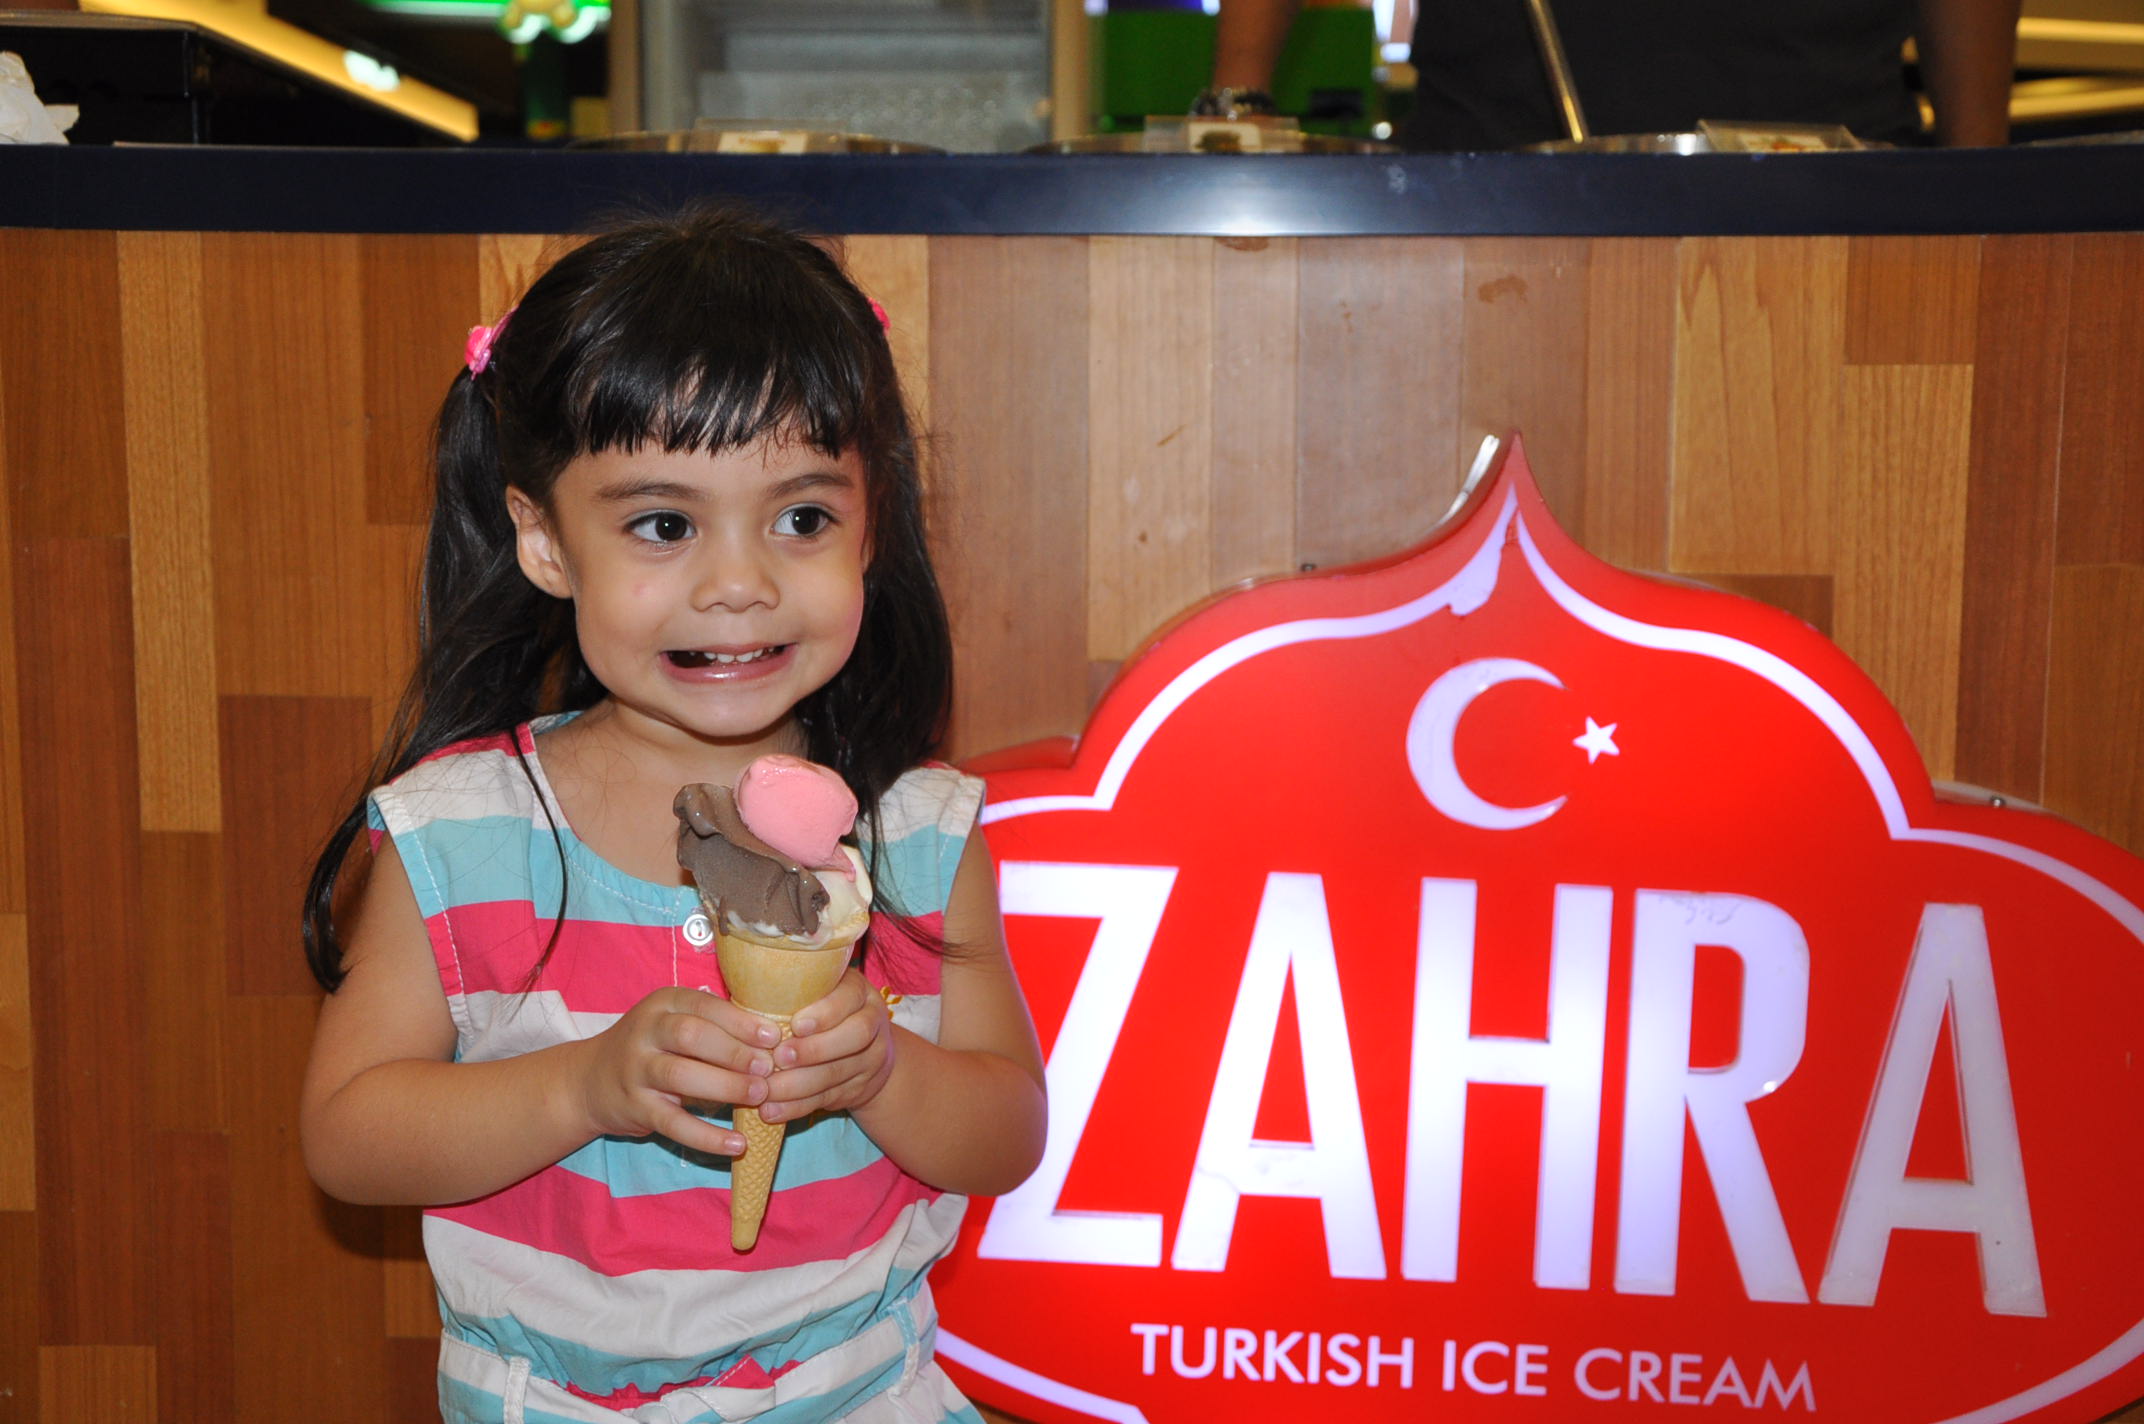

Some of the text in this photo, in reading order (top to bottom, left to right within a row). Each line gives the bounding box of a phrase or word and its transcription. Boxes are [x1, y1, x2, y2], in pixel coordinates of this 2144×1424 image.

[977, 861, 2048, 1316] ZAHRA
[1130, 1323, 1816, 1412] TURKISH ICE CREAM
